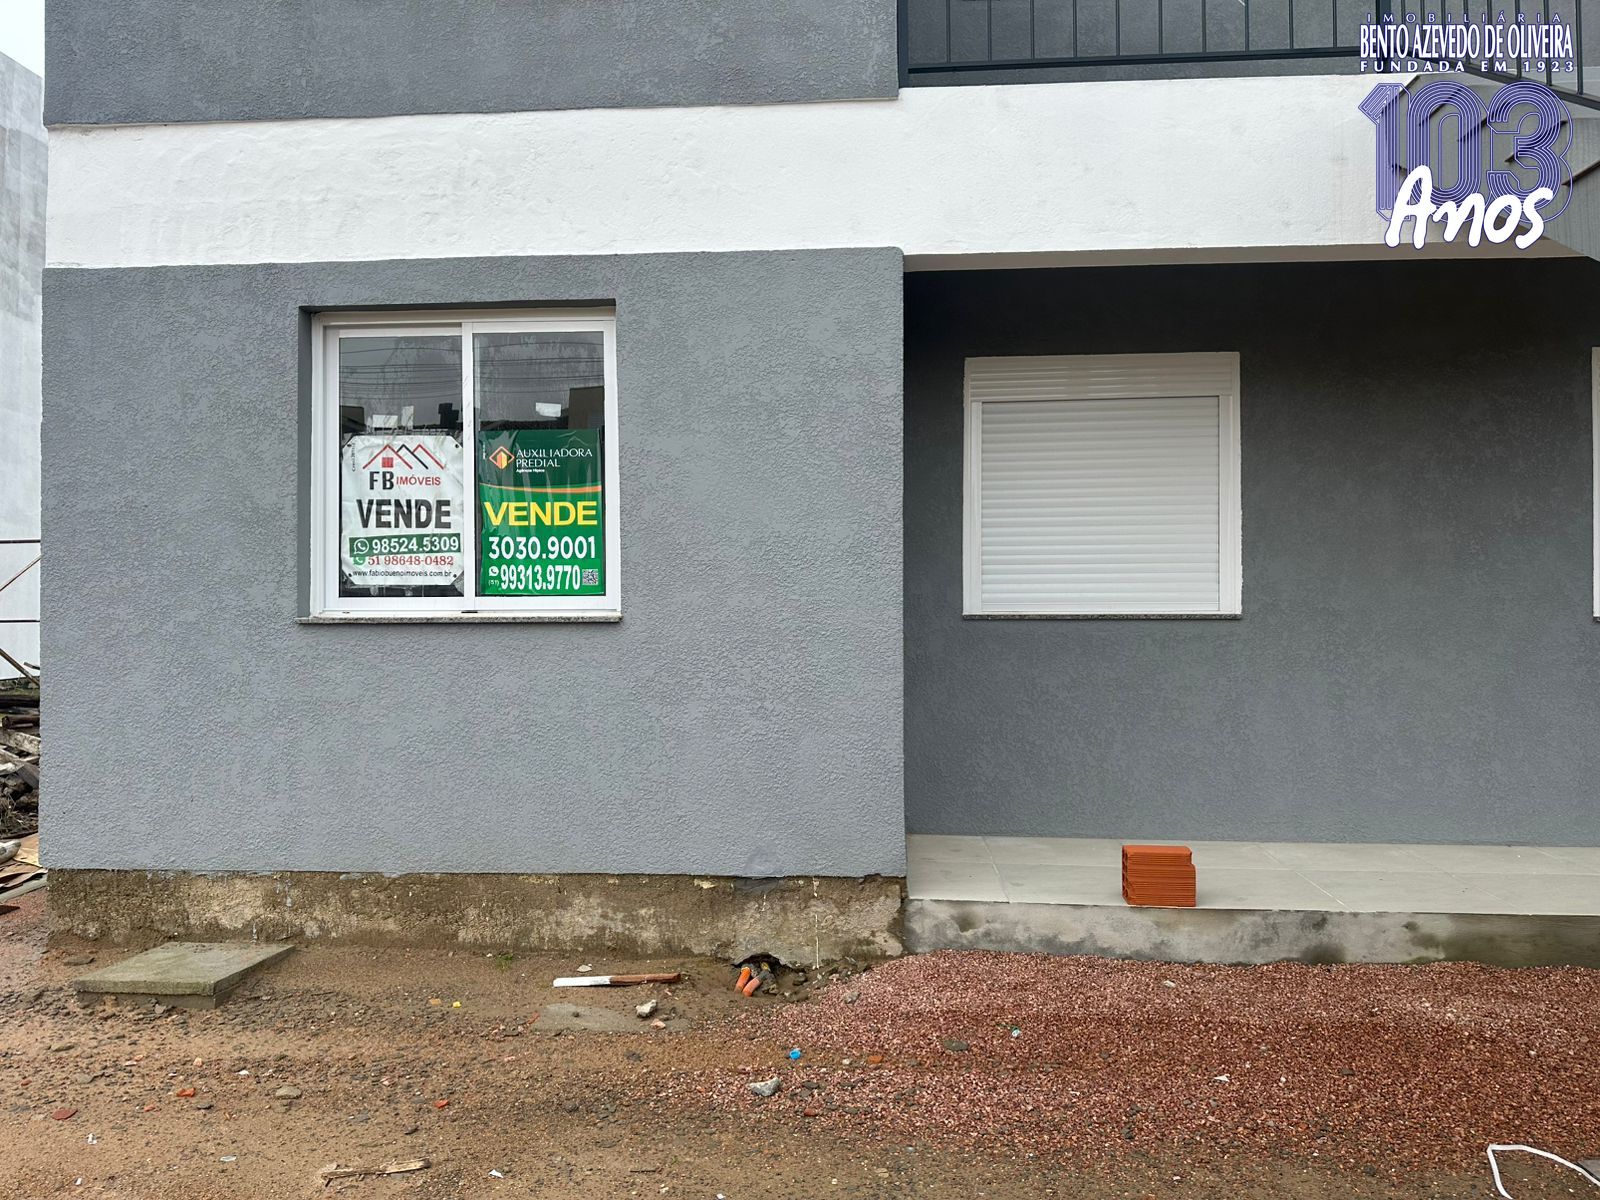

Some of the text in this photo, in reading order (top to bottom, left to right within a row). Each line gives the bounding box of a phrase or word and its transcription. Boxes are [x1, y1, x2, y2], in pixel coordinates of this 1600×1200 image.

[516, 448, 593, 458] AUXILIADORA
[516, 459, 561, 468] PREDIAL
[369, 471, 441, 490] FB IMÓVEIS
[356, 499, 452, 529] VENDE
[484, 501, 598, 526] VENDE
[372, 536, 459, 554] 98524.5309
[488, 536, 595, 559] 3030.9001
[384, 555, 454, 566] 98648-0482
[500, 564, 580, 590] 99313.9770
